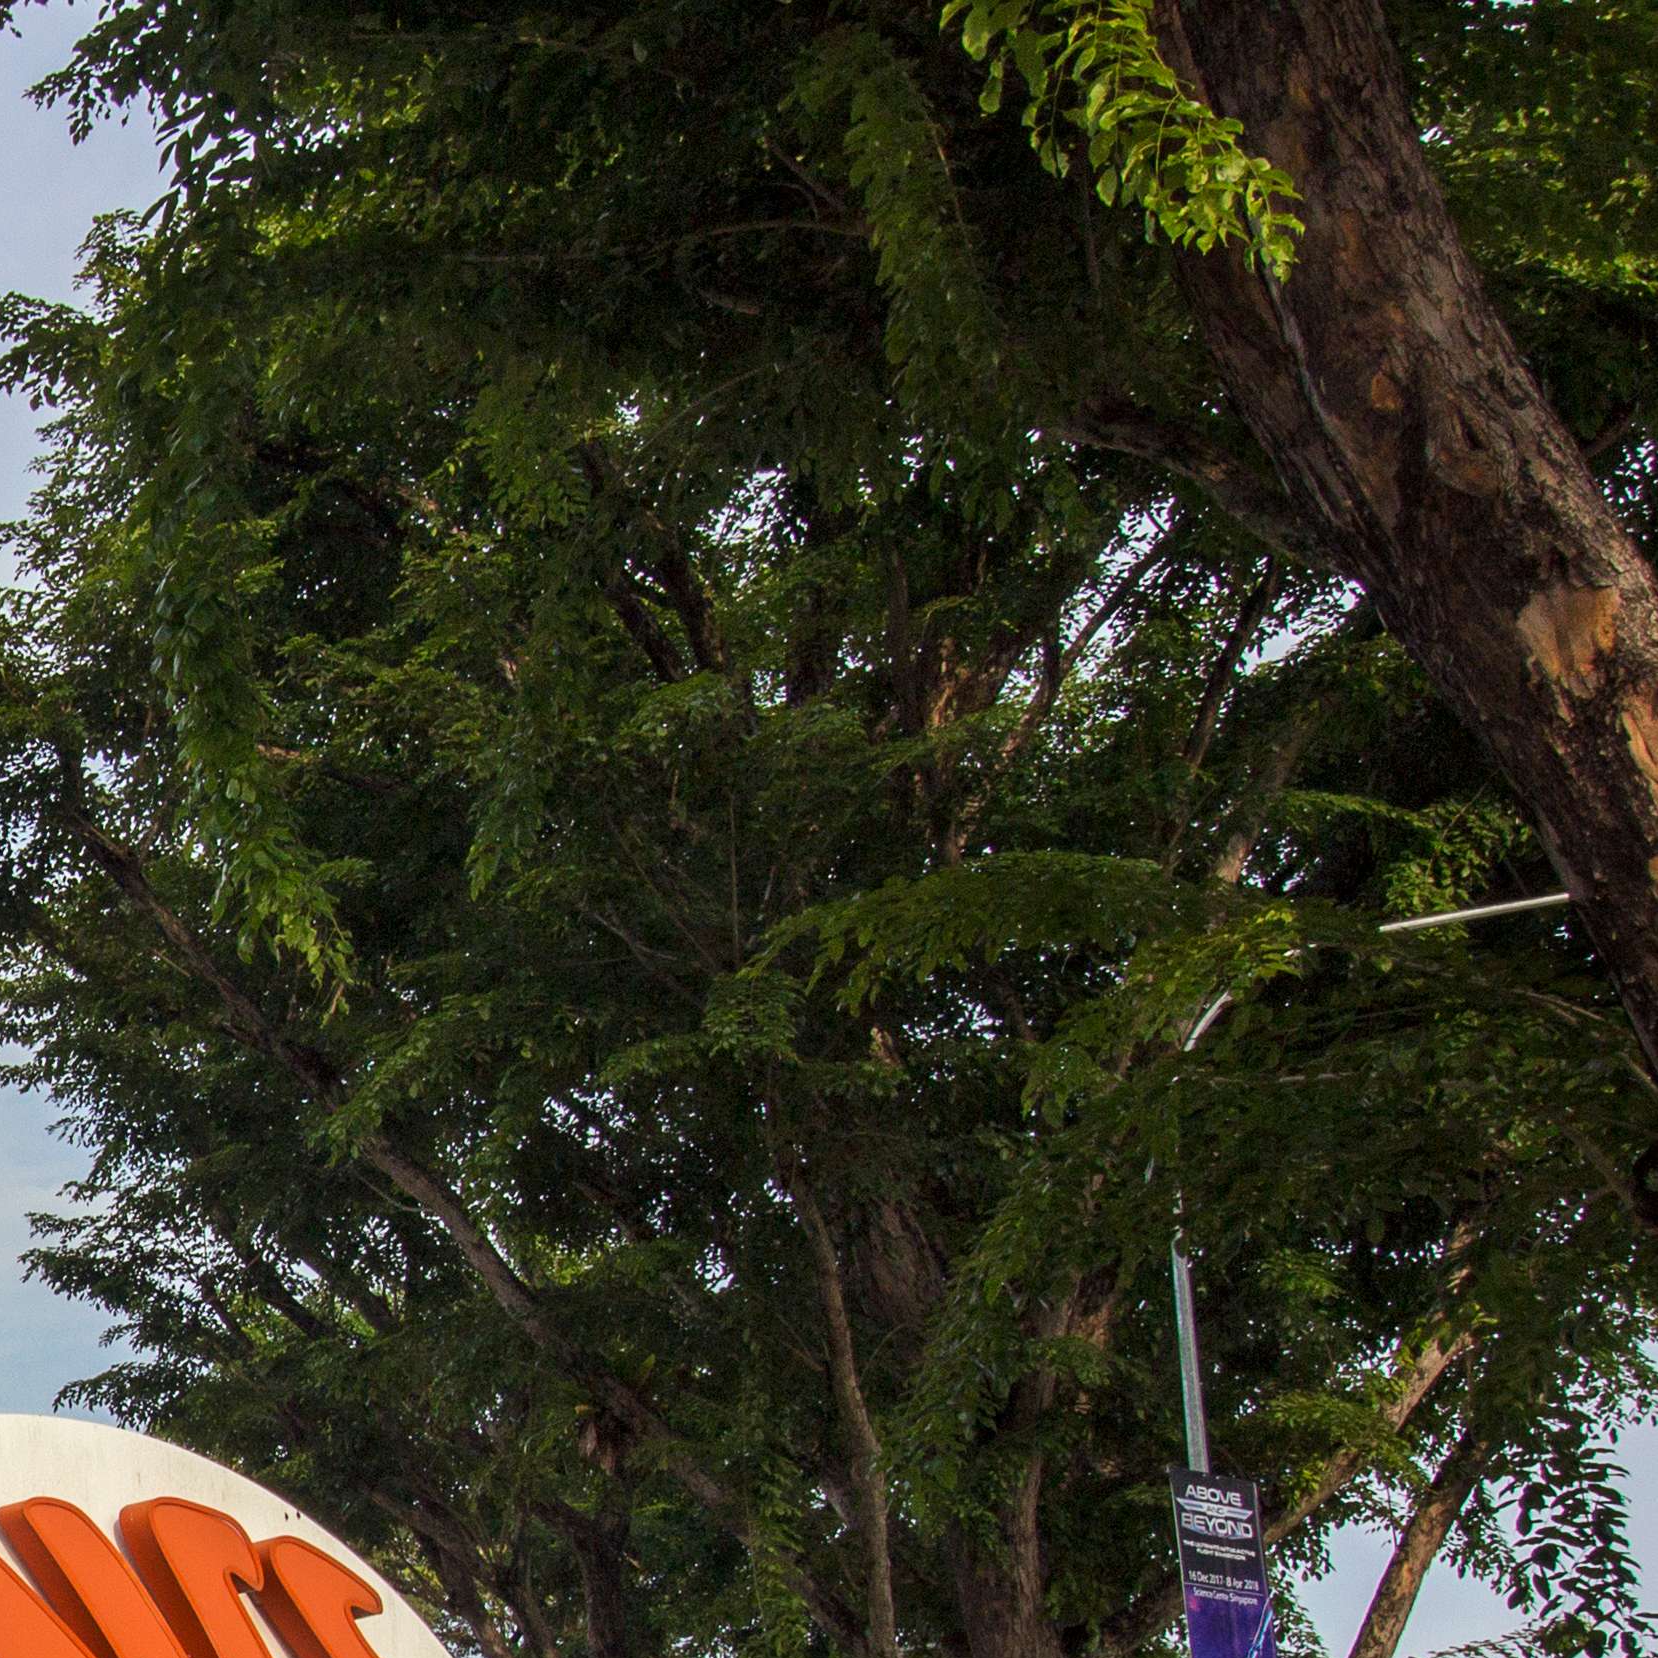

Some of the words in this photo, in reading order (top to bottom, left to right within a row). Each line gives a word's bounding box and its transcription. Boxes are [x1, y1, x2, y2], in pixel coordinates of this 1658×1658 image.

[1185, 1484, 1242, 1506] ABOVE
[1181, 1512, 1253, 1538] BEYOND
[1197, 1571, 1209, 1583] Dec
[1209, 1573, 1223, 1585] 2017
[1229, 1591, 1258, 1605] Singapore
